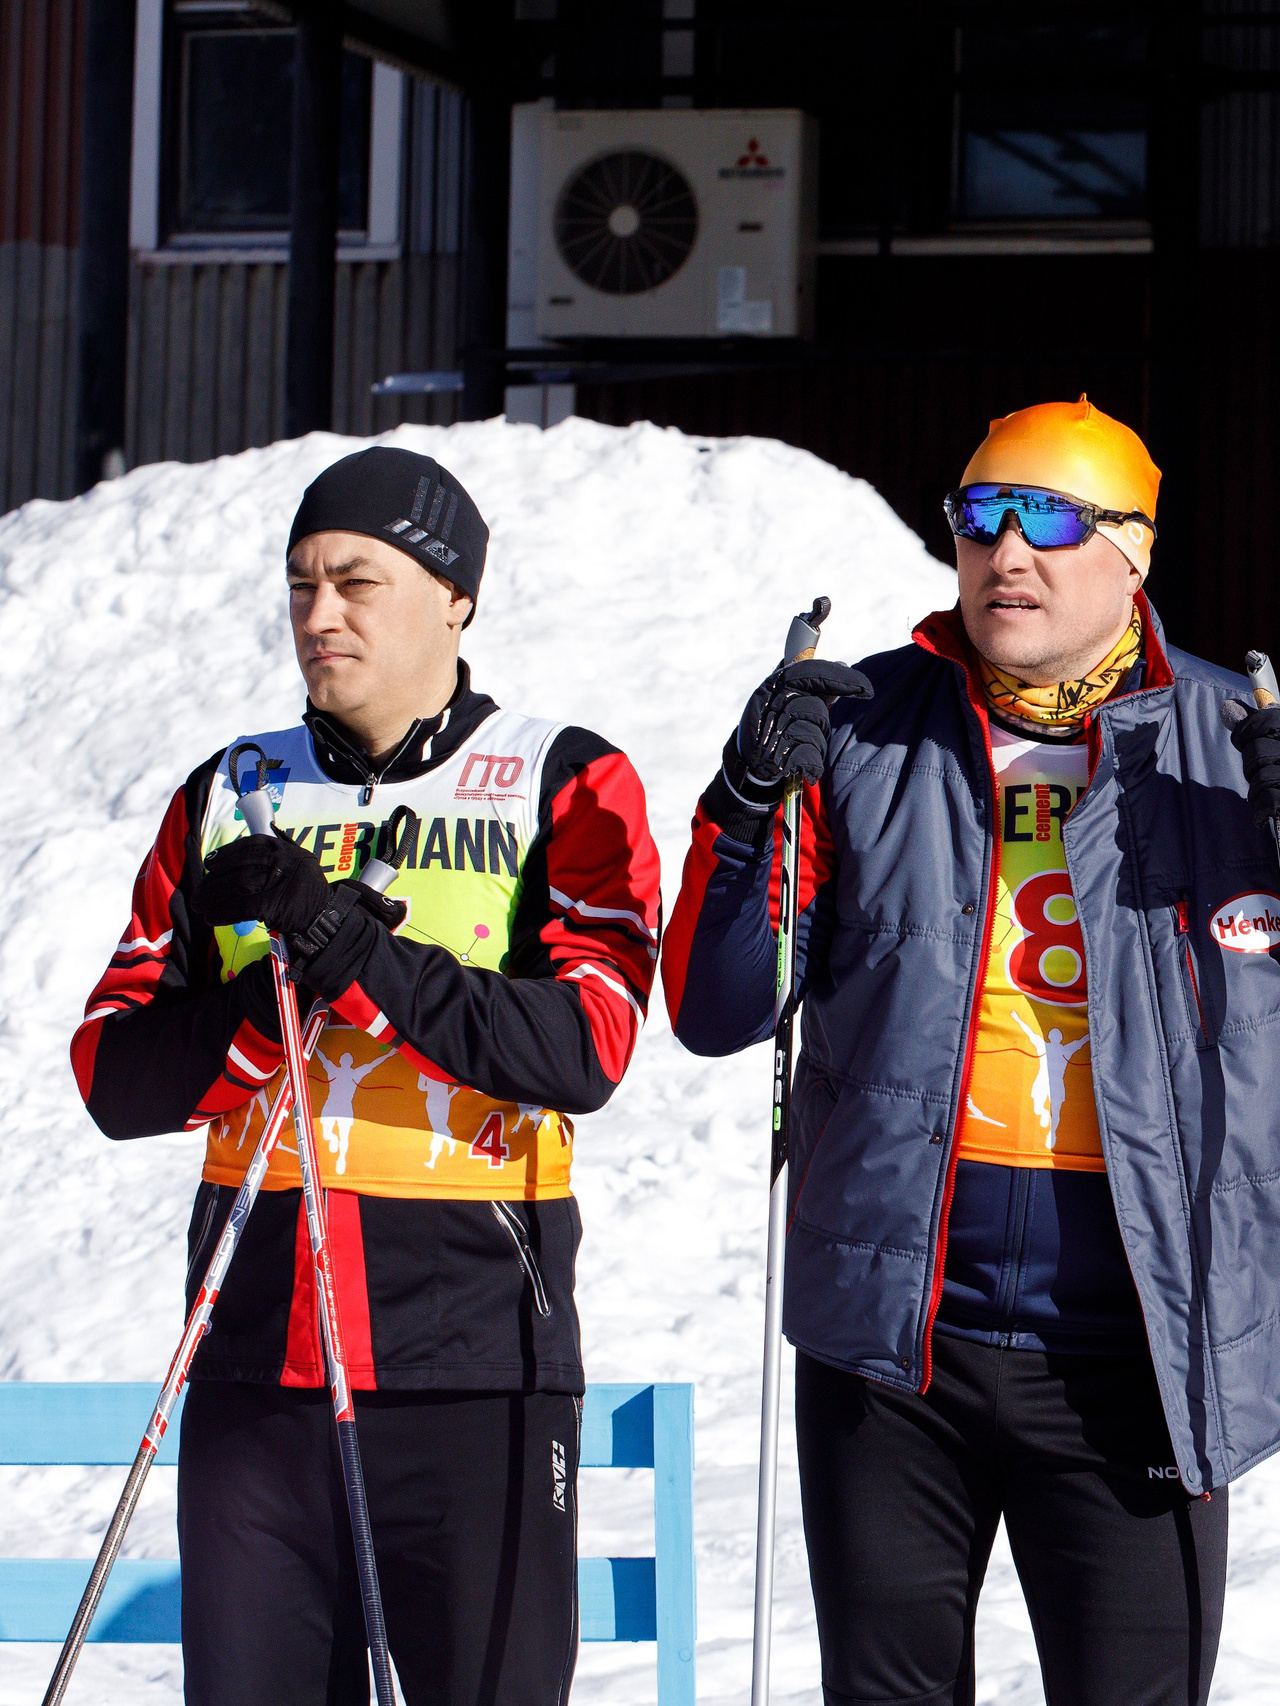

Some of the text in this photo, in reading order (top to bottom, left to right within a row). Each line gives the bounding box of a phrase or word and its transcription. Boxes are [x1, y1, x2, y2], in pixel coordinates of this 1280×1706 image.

[457, 752, 525, 788] ГТО
[1033, 783, 1051, 842] cement
[338, 822, 358, 871] cement
[1004, 869, 1088, 1007] 8
[468, 1111, 509, 1169] 4
[1147, 1466, 1180, 1479] NO
